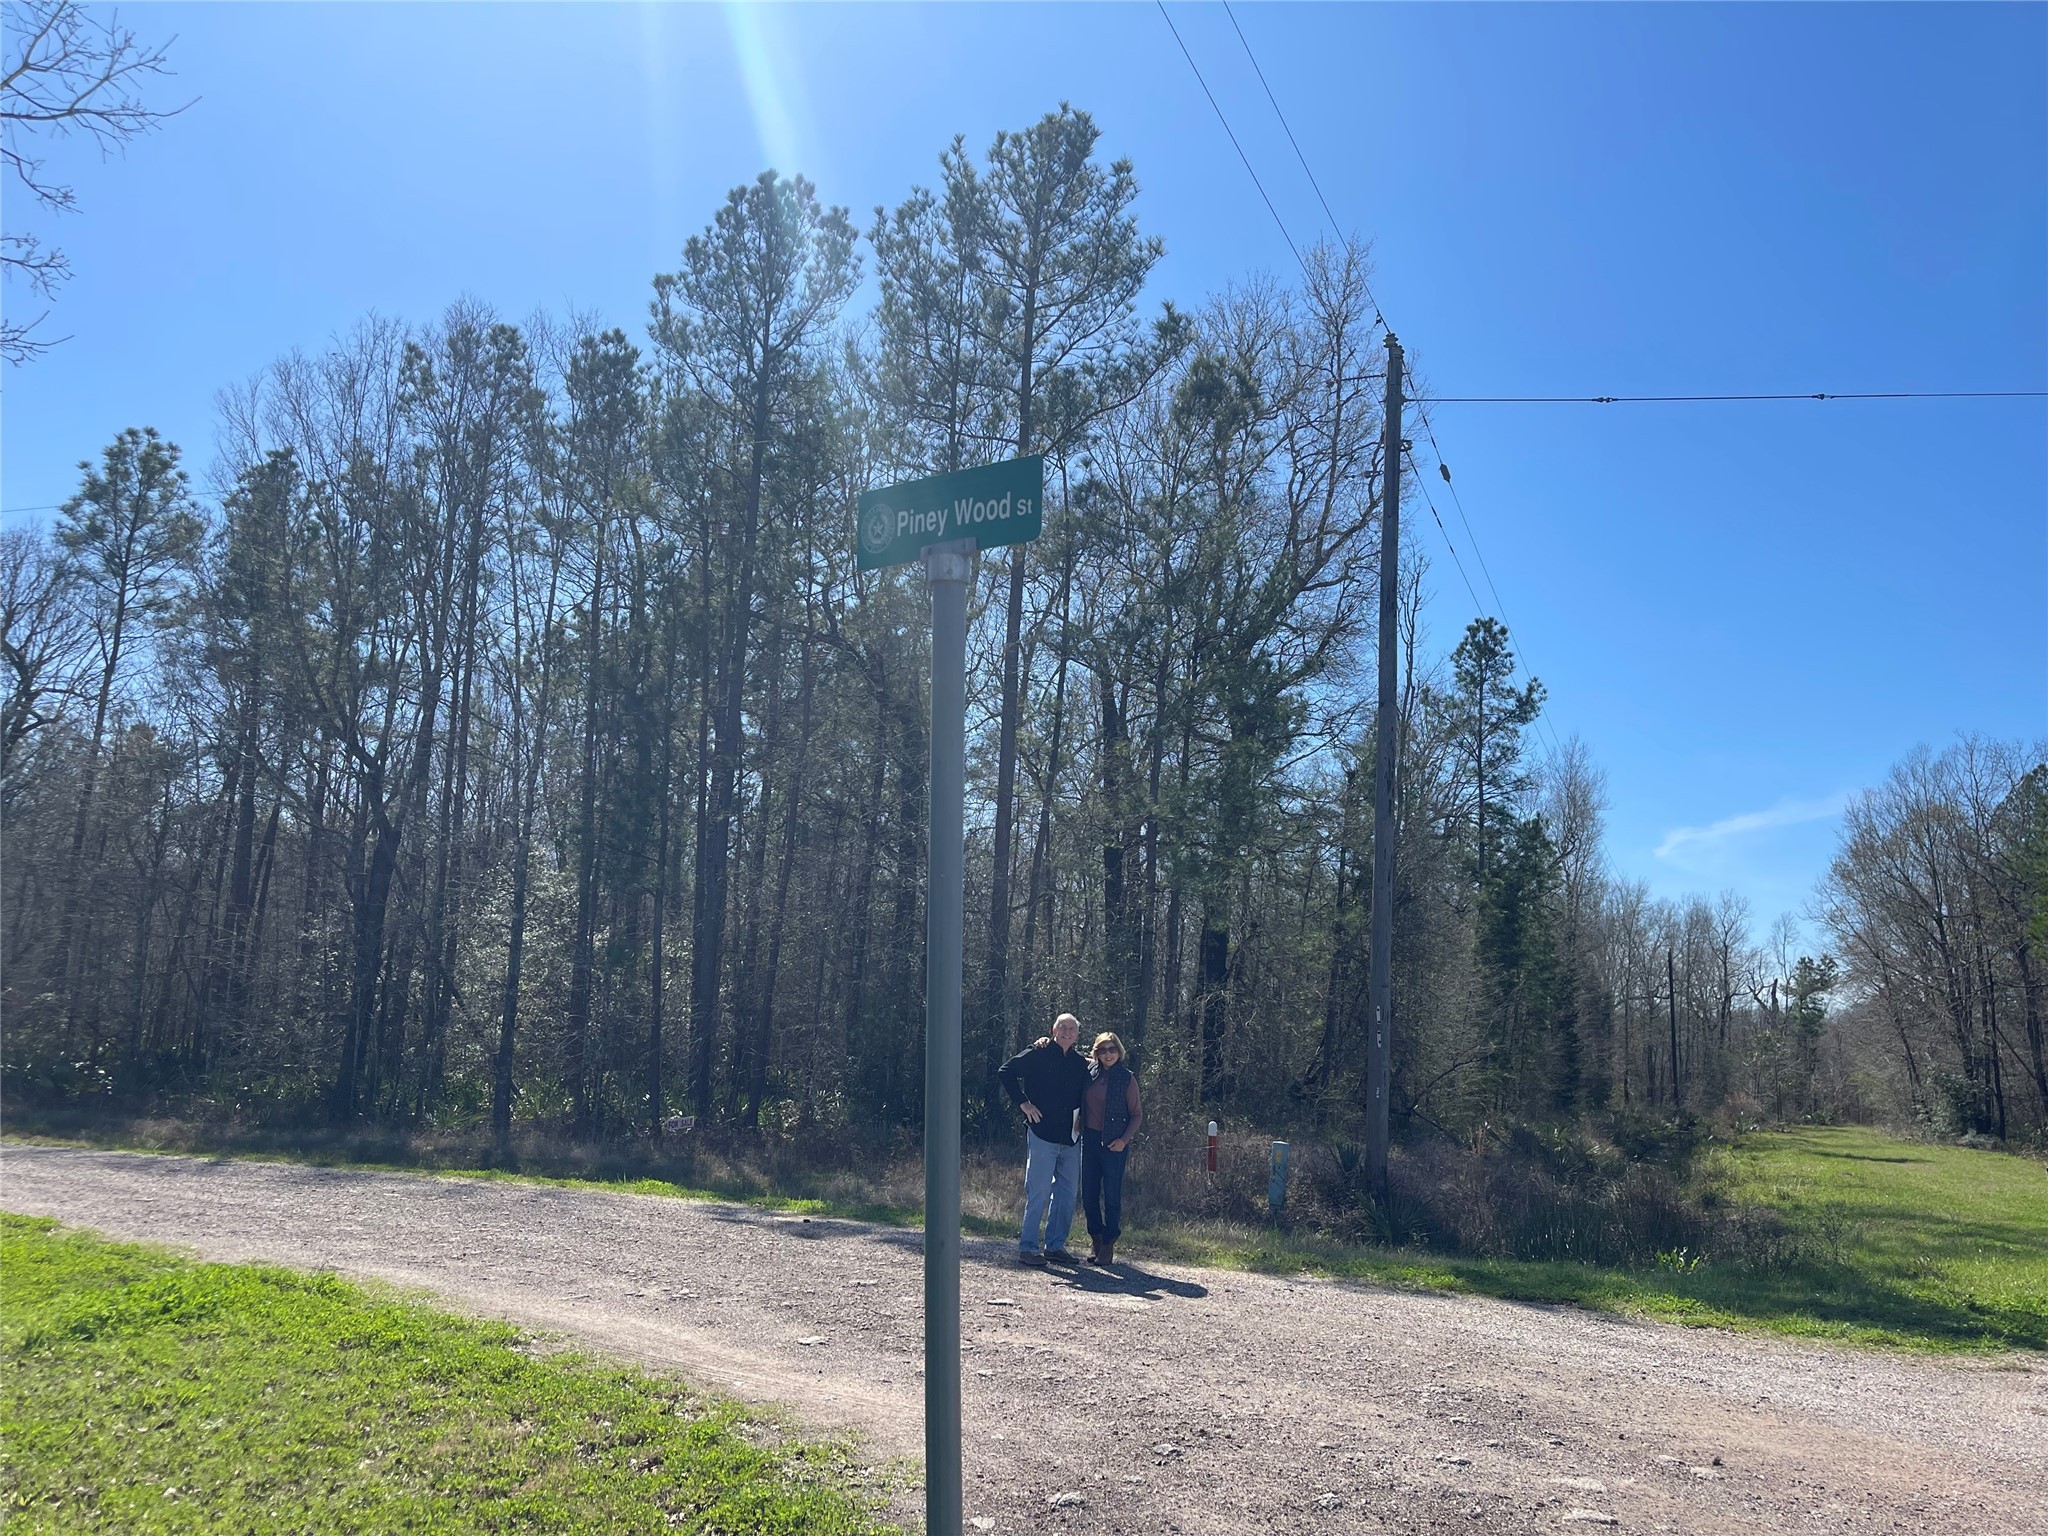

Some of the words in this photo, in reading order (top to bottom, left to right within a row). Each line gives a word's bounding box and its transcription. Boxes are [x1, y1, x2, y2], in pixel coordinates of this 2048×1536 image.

[897, 508, 948, 537] Piney
[954, 491, 1011, 526] Wood
[1017, 498, 1032, 516] St
[668, 1120, 678, 1129] FOR
[680, 1118, 693, 1127] SALE
